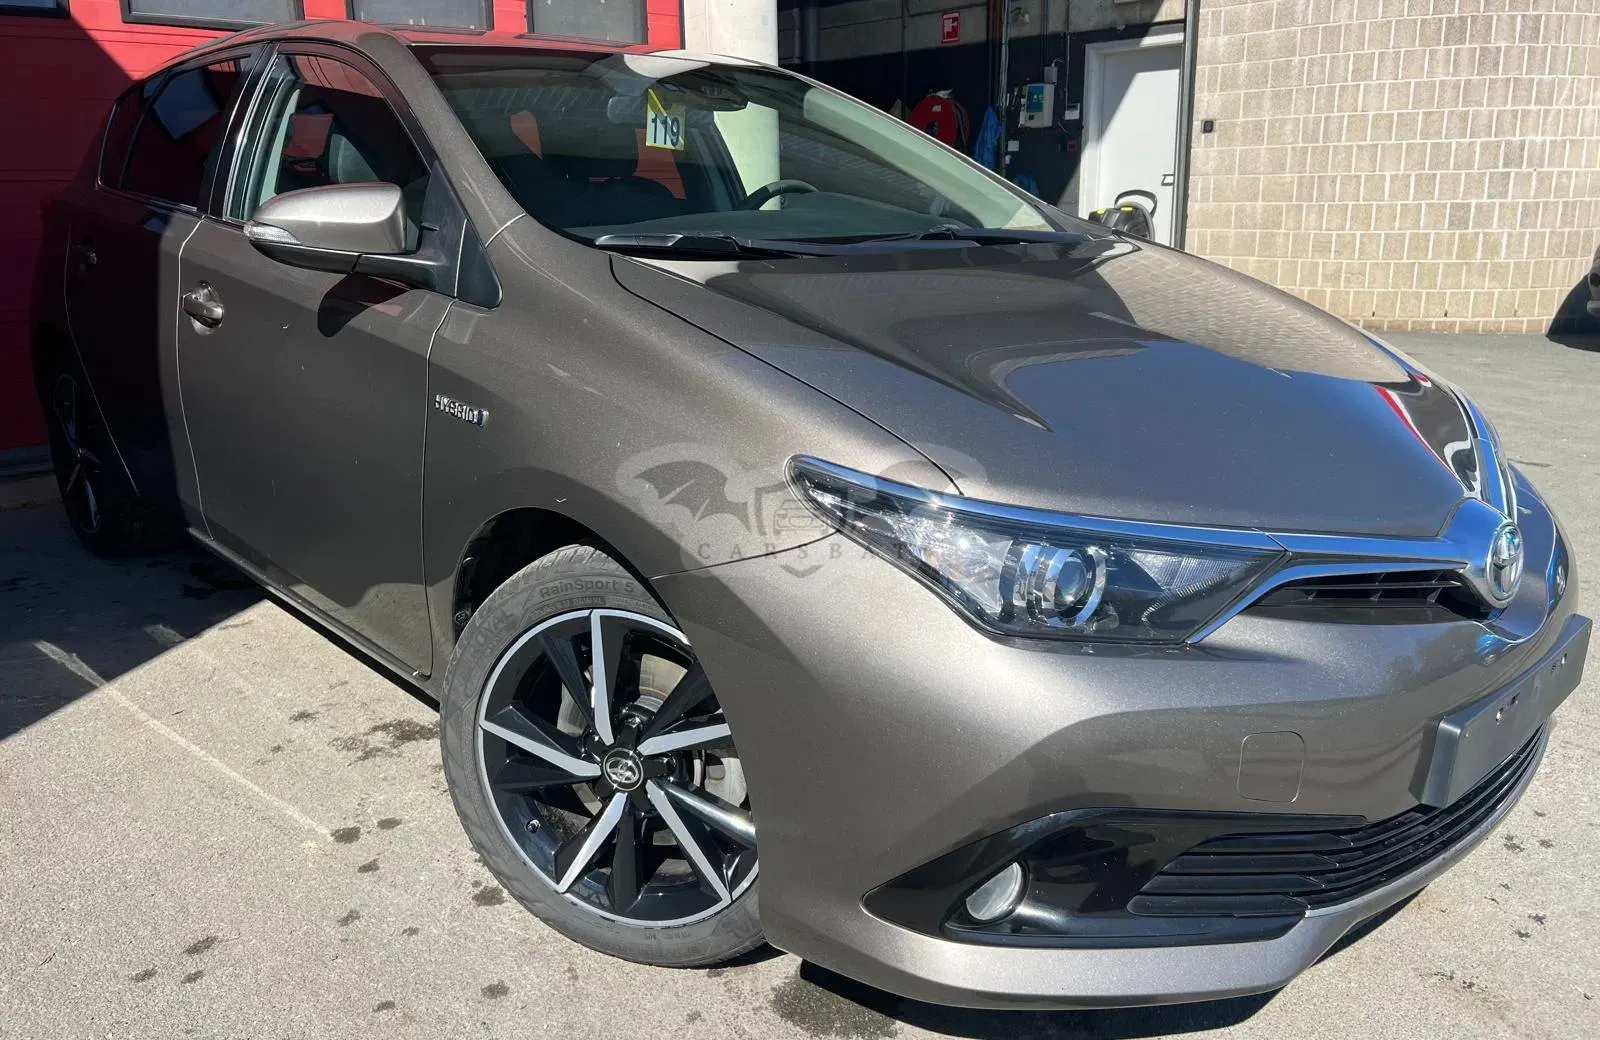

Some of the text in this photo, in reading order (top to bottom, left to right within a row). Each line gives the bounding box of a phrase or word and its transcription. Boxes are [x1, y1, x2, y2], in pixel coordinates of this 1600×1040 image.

[651, 113, 680, 147] 119
[540, 579, 635, 599] RainSport 5
